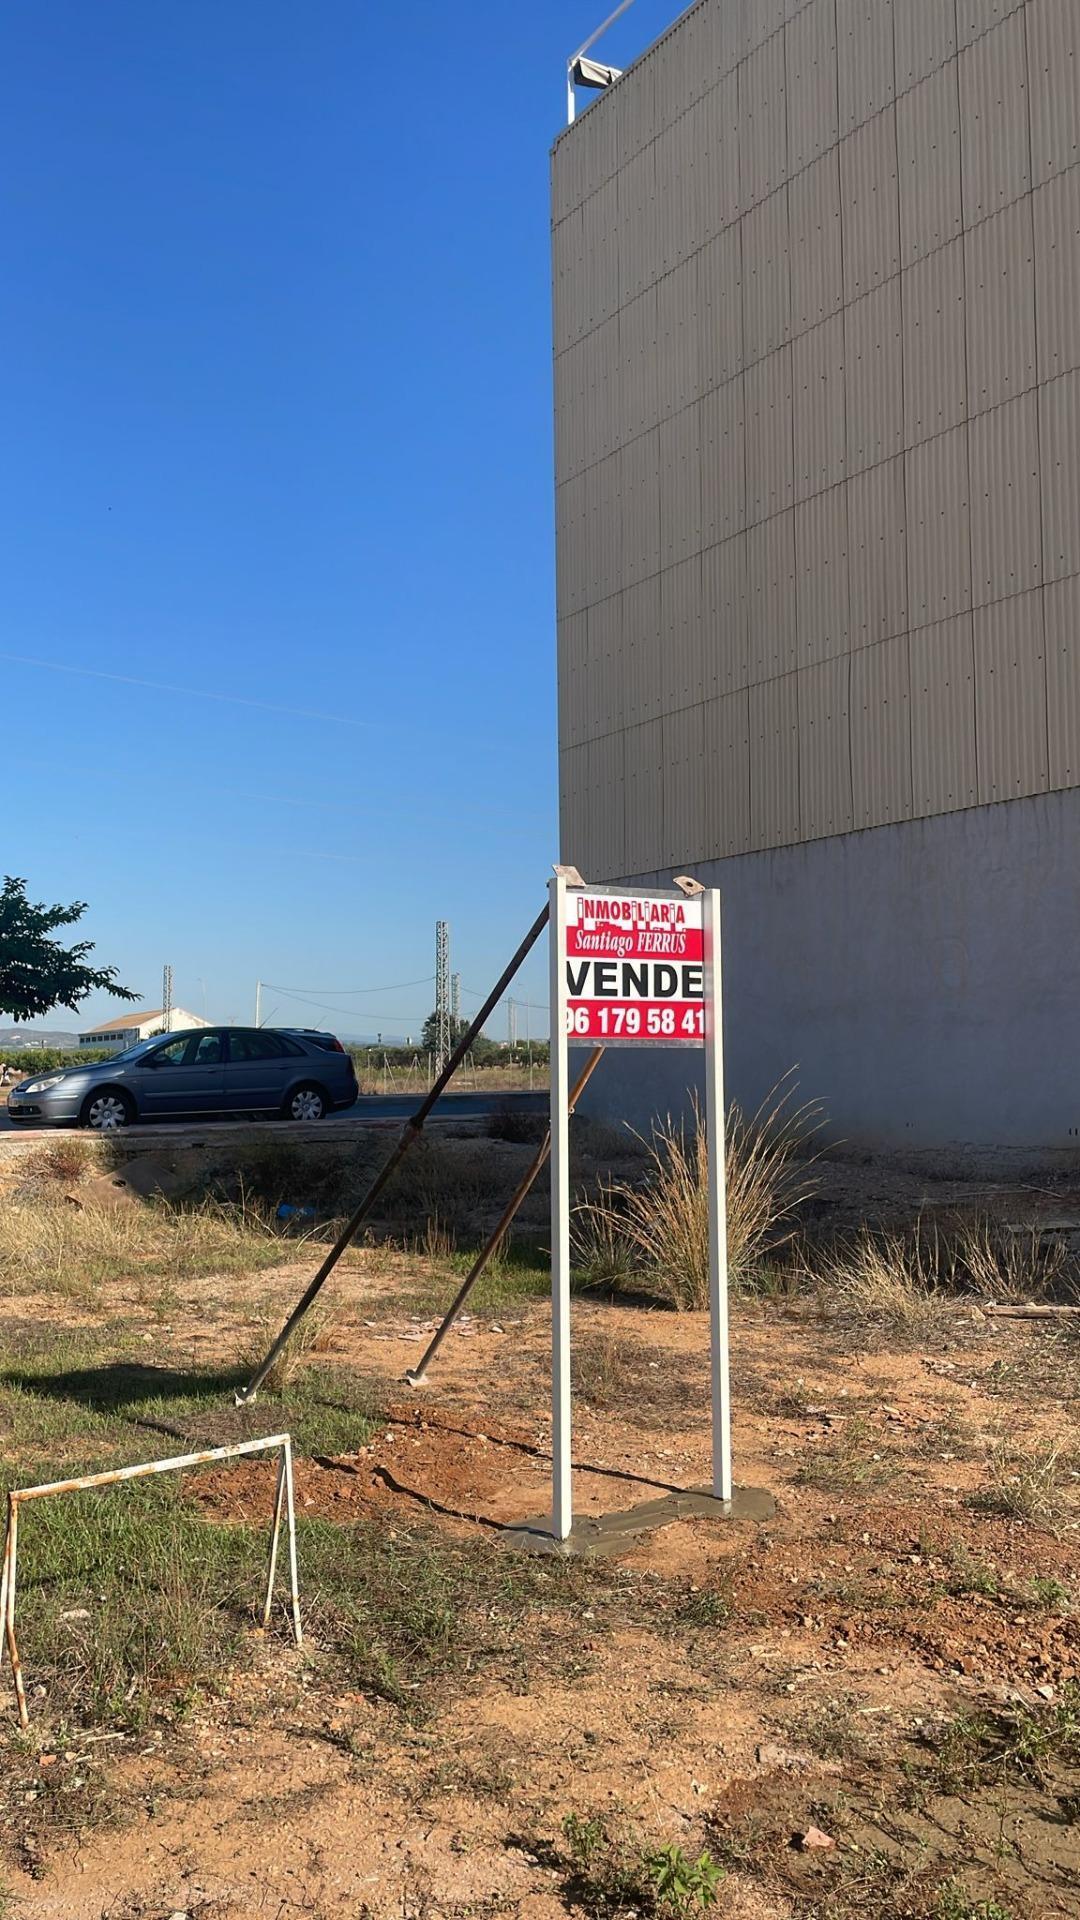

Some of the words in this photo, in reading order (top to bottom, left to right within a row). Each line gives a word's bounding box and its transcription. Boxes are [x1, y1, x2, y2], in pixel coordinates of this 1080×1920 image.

[575, 930, 633, 957] Santiago
[637, 932, 686, 953] FERRUS
[566, 961, 703, 998] VENDE
[597, 1007, 640, 1034] 179
[647, 1008, 675, 1034] 58
[681, 1009, 704, 1034] 41
